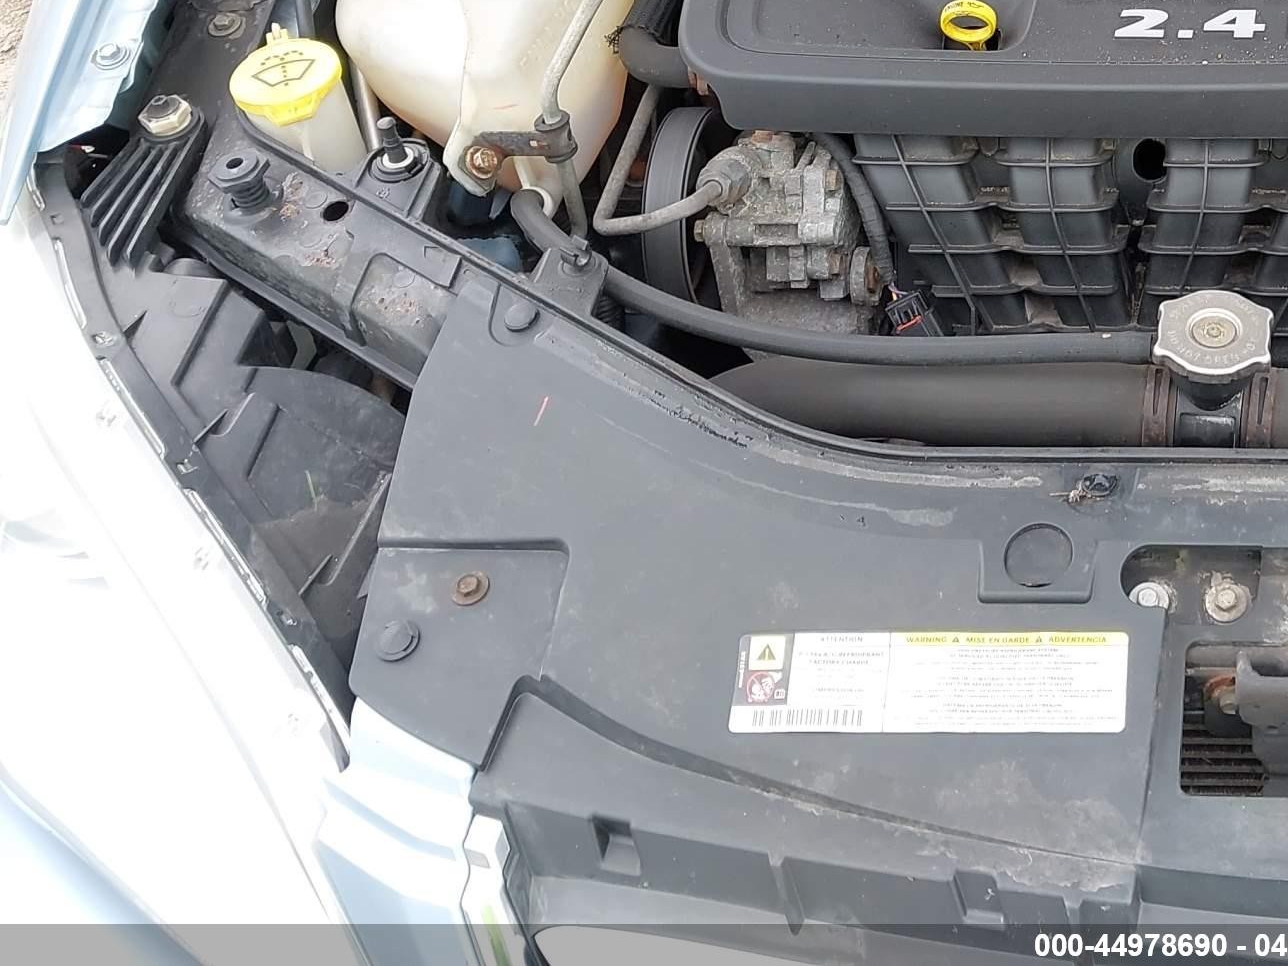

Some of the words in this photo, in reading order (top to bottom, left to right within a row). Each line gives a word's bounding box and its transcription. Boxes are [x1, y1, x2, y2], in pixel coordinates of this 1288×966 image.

[1114, 8, 1267, 40] 2.4
[966, 636, 986, 644] MISE
[989, 636, 1000, 644] EN
[1002, 636, 1030, 644] GARDE
